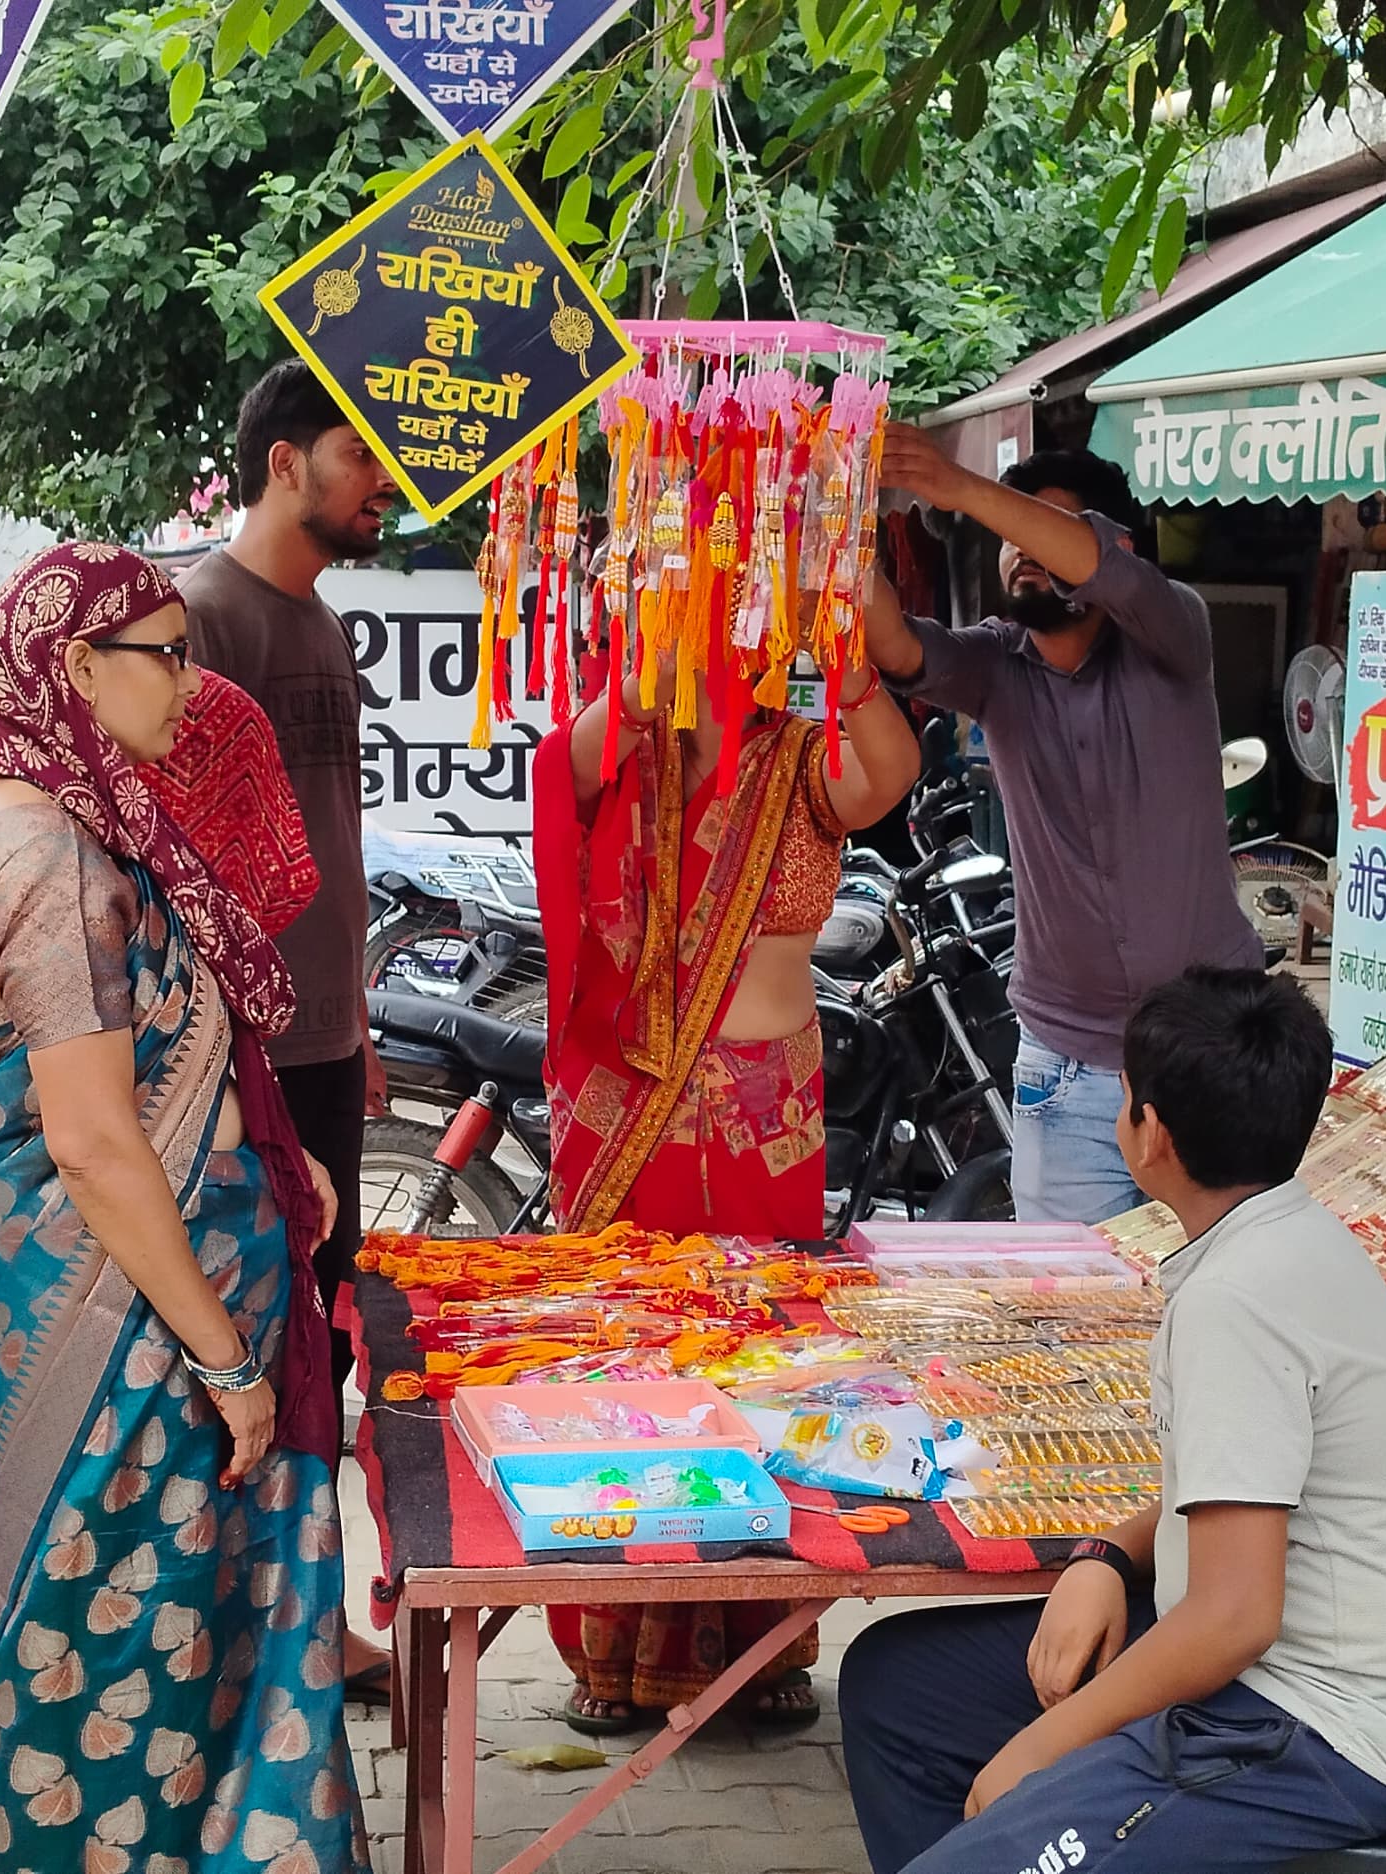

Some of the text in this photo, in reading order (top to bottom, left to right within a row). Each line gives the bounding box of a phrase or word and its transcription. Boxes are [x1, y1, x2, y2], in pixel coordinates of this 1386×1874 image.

[424, 47, 518, 76] यहाँ से
[429, 78, 518, 107] खरीदें
[434, 185, 494, 214] Hari
[409, 203, 512, 238] Darshan
[437, 236, 475, 249] RAKHI
[376, 246, 545, 308] राखियाँ
[424, 305, 479, 357] ही
[364, 358, 532, 420] राखियाँ
[397, 415, 489, 445] यहाँ से
[399, 444, 485, 474] खरीदें
[1018, 1827, 1087, 1874] ds
